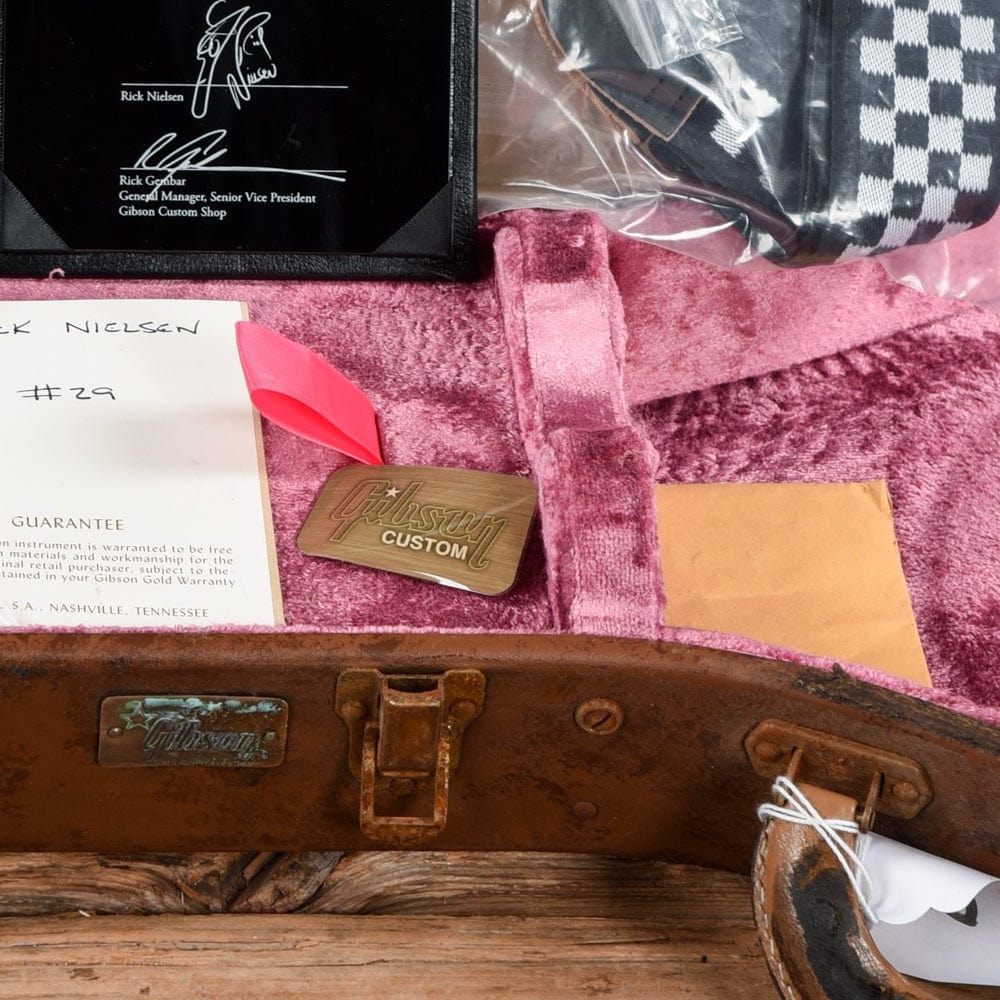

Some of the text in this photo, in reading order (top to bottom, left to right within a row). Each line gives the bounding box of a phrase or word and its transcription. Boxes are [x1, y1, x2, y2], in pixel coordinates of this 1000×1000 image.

[121, 90, 184, 102] Rick Nielsen
[119, 175, 143, 185] Rick
[161, 191, 207, 203] Manager,
[210, 191, 243, 202] Senior
[245, 192, 267, 202] Vice
[270, 192, 316, 203] President
[118, 205, 227, 220] Gibson Custom Shop
[65, 319, 201, 335] NIELSEN
[17, 384, 117, 401] #29
[11, 515, 124, 530] GUARANTEE
[329, 479, 508, 571] Gibson
[381, 529, 469, 561] CUSTOM
[49, 603, 128, 615] NASHVILLE,
[135, 607, 208, 617] TENNESSEE
